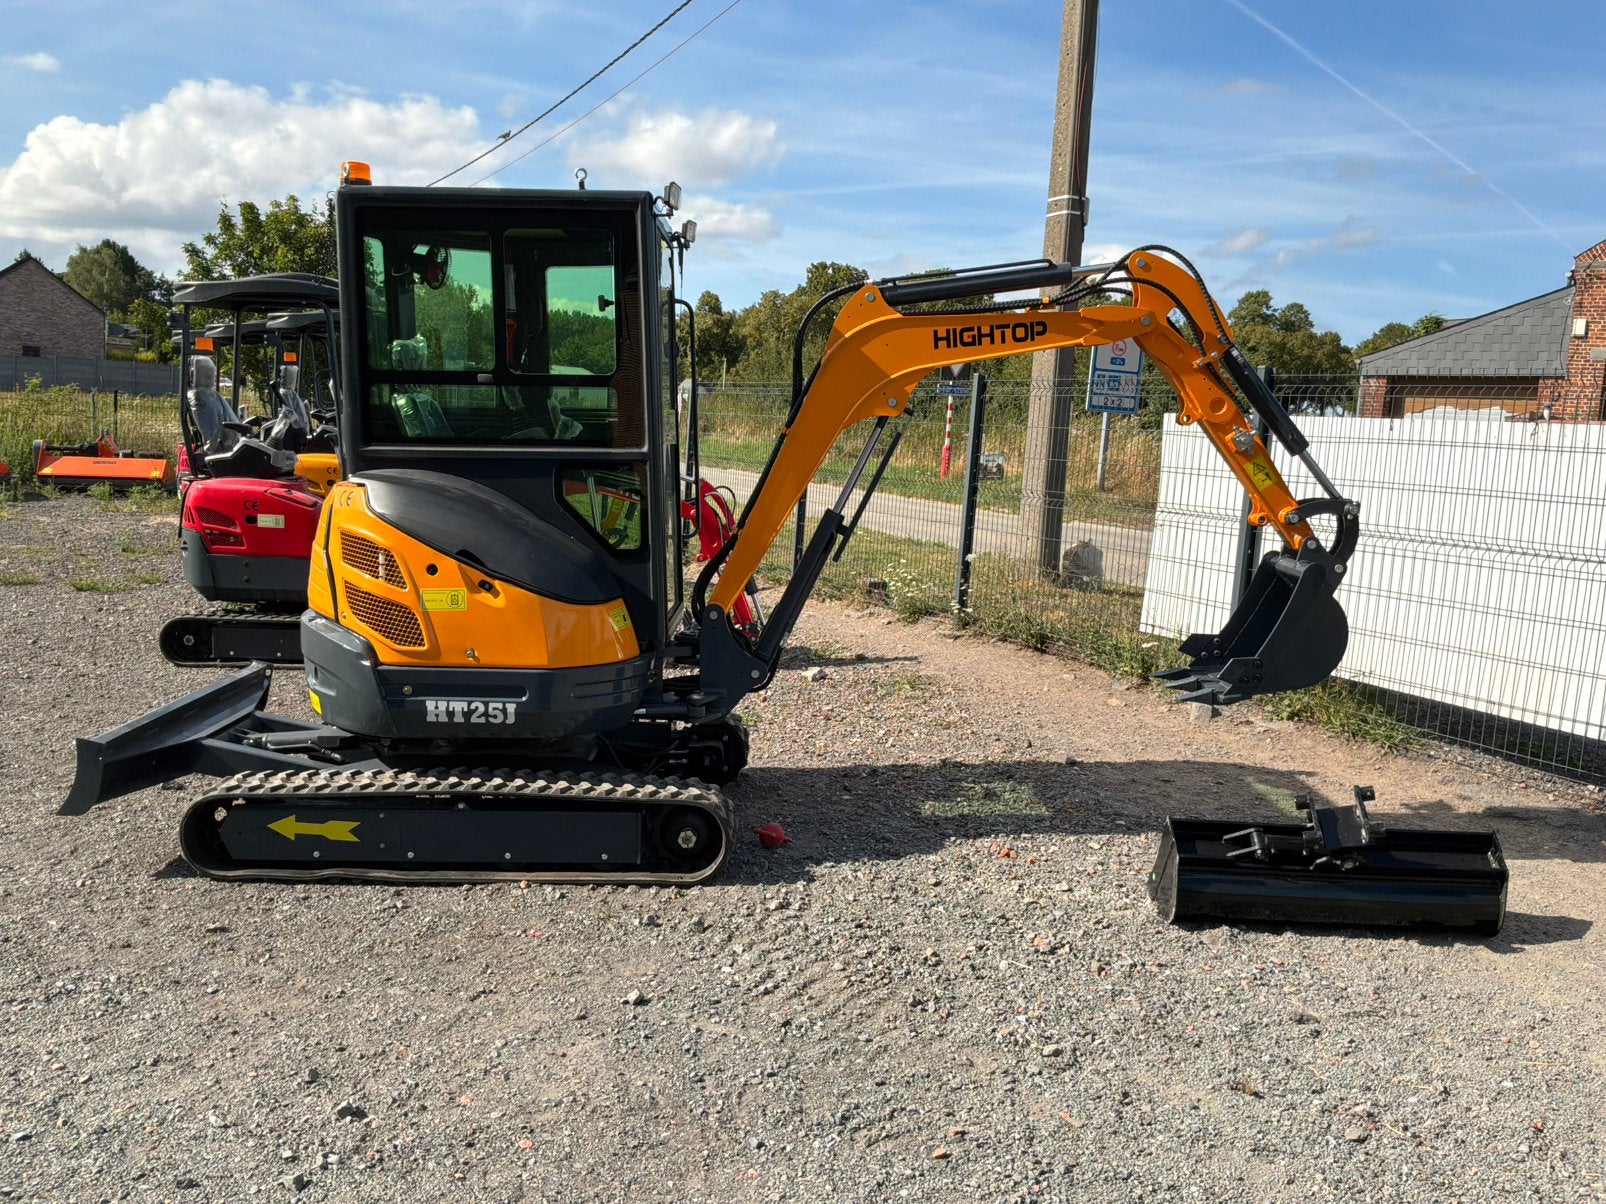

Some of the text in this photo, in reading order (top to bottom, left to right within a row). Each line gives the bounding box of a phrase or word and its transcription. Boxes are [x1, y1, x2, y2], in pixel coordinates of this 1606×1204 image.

[933, 320, 1048, 350] HIGHTOP
[1104, 397, 1109, 406] 2
[1117, 398, 1123, 407] 2
[326, 466, 339, 475] CE
[244, 500, 260, 512] CE
[425, 700, 517, 724] HT25J
